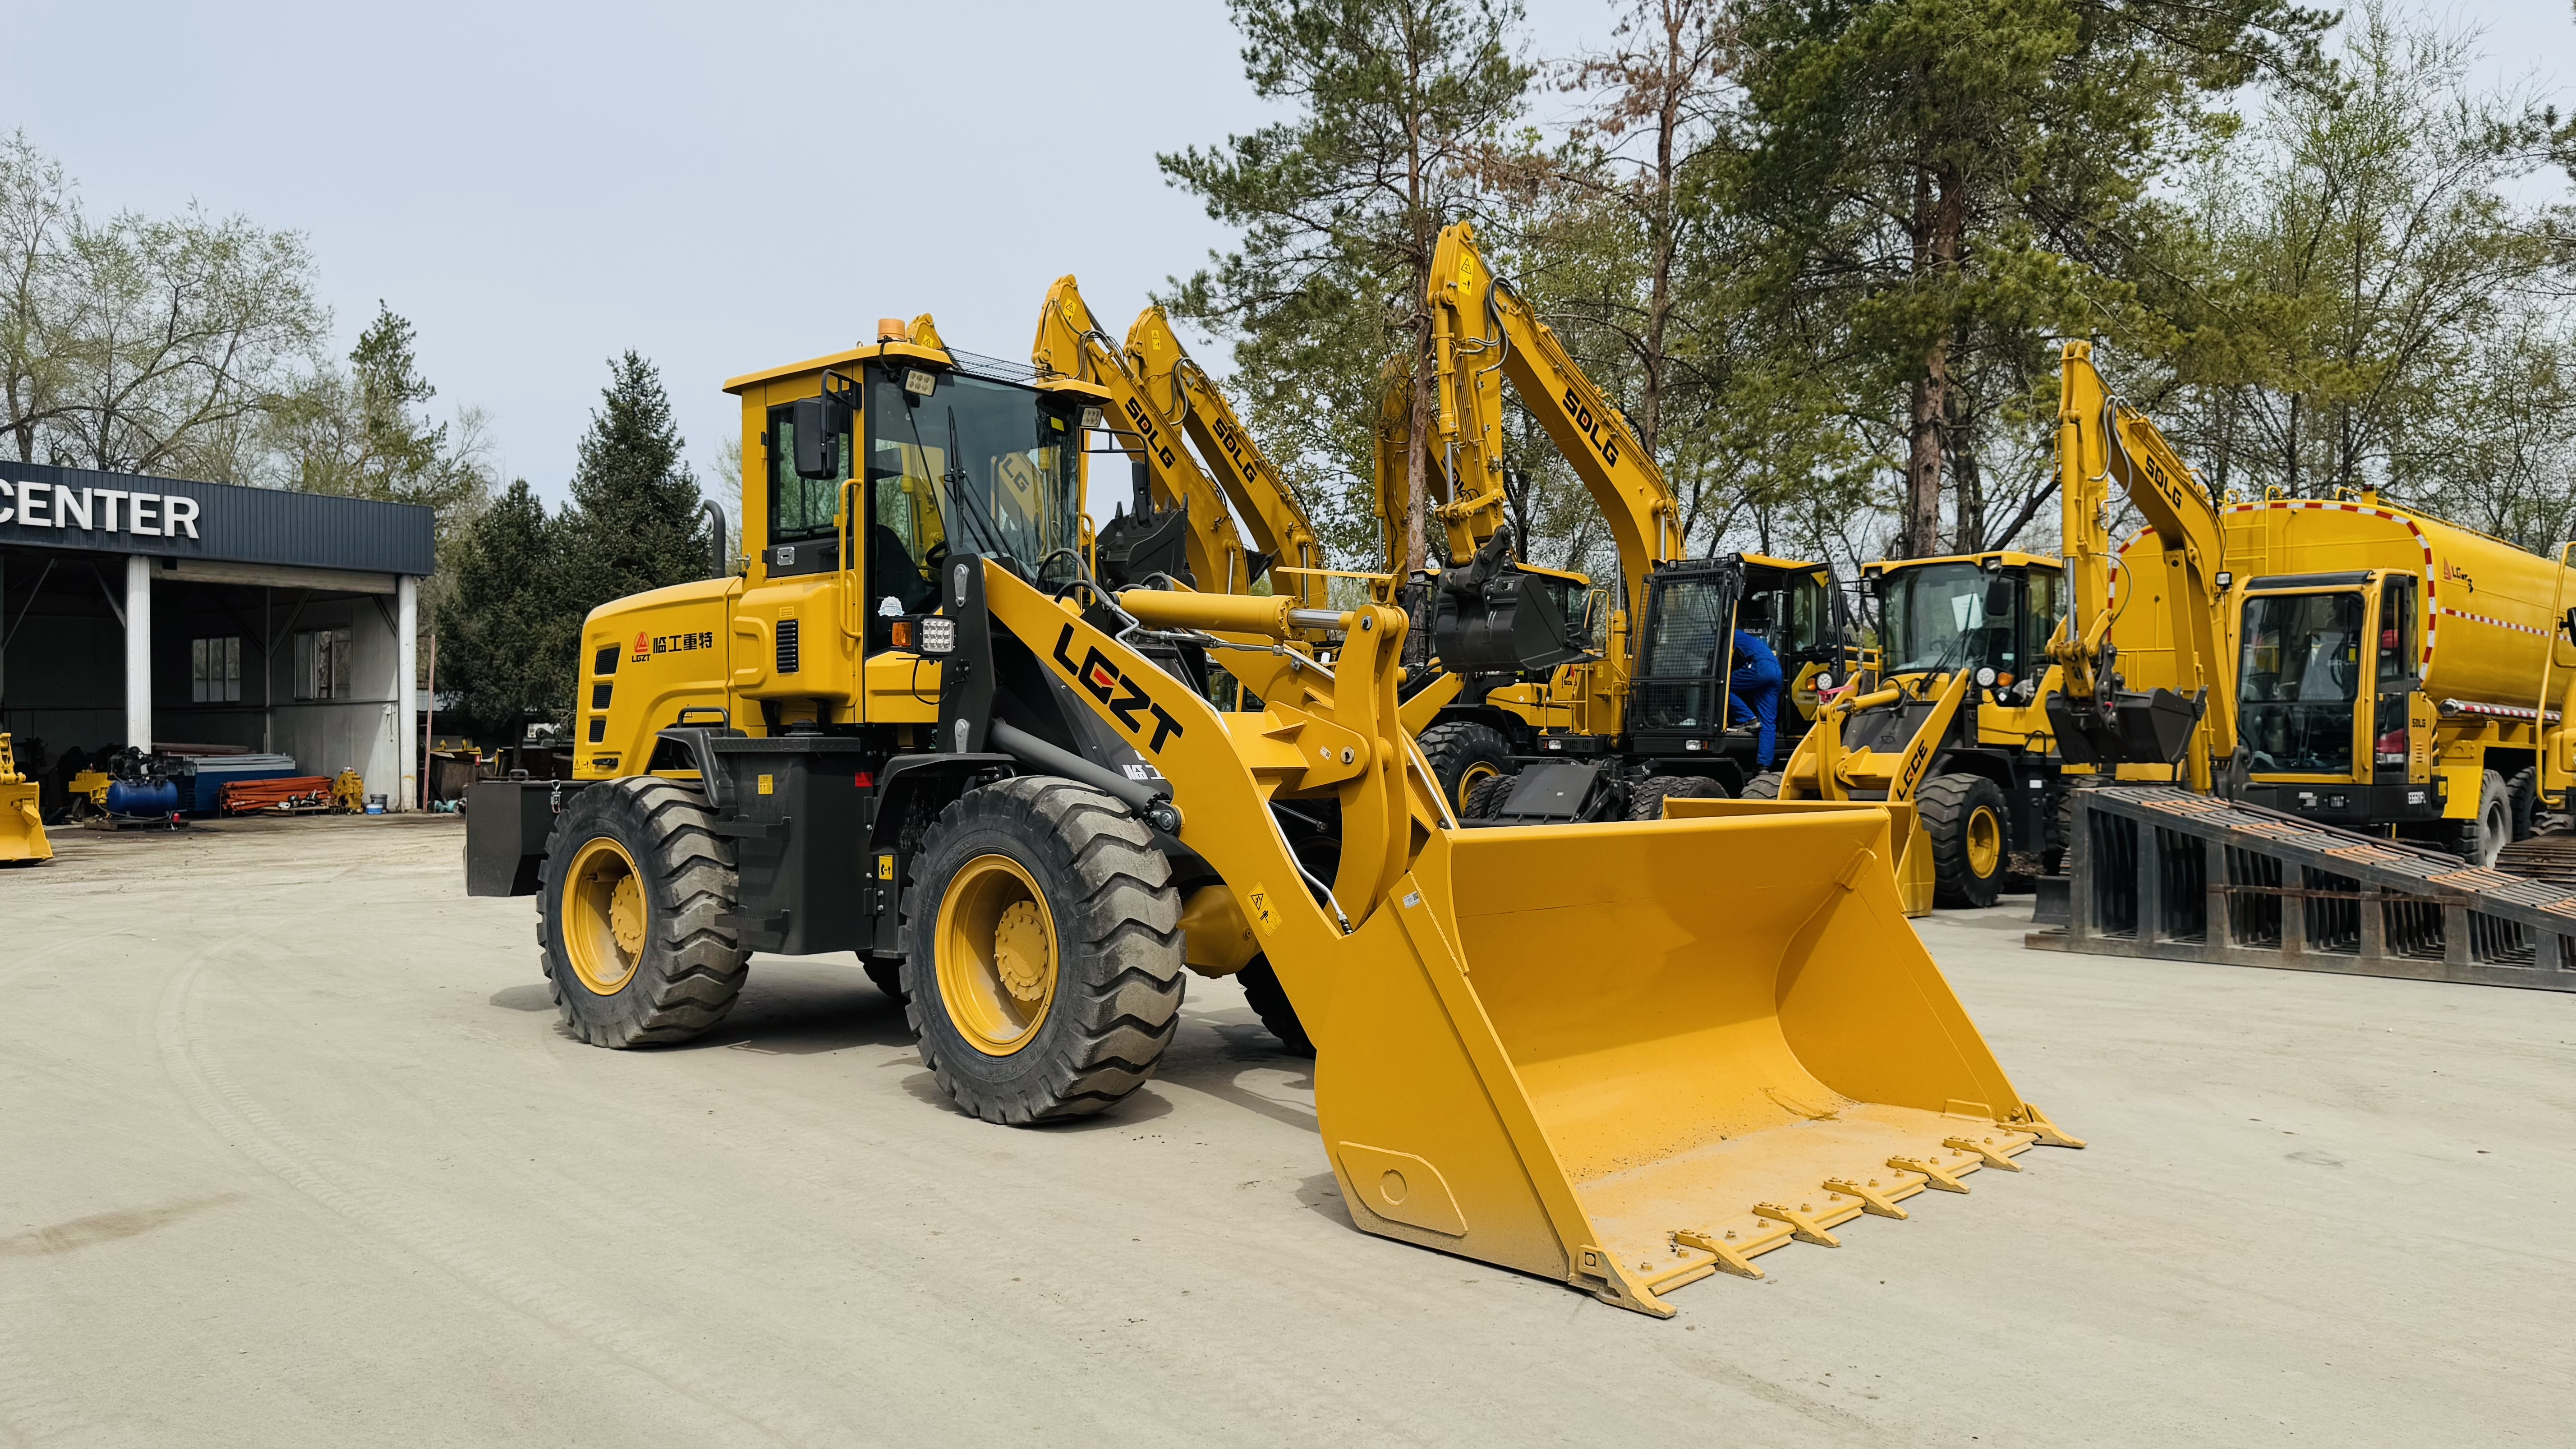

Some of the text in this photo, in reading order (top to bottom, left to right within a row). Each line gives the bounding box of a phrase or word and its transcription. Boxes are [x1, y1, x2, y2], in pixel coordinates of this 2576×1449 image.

[1125, 396, 1176, 469] SDLG
[1212, 418, 1257, 484] SDLG
[1563, 387, 1619, 468] SDLG
[2145, 454, 2182, 510] SDLG
[632, 654, 651, 662] LGZT
[653, 632, 713, 653] 临工重特
[1053, 622, 1183, 755] LGZT
[2412, 718, 2426, 727] SDLG
[1897, 739, 1928, 801] LGCE
